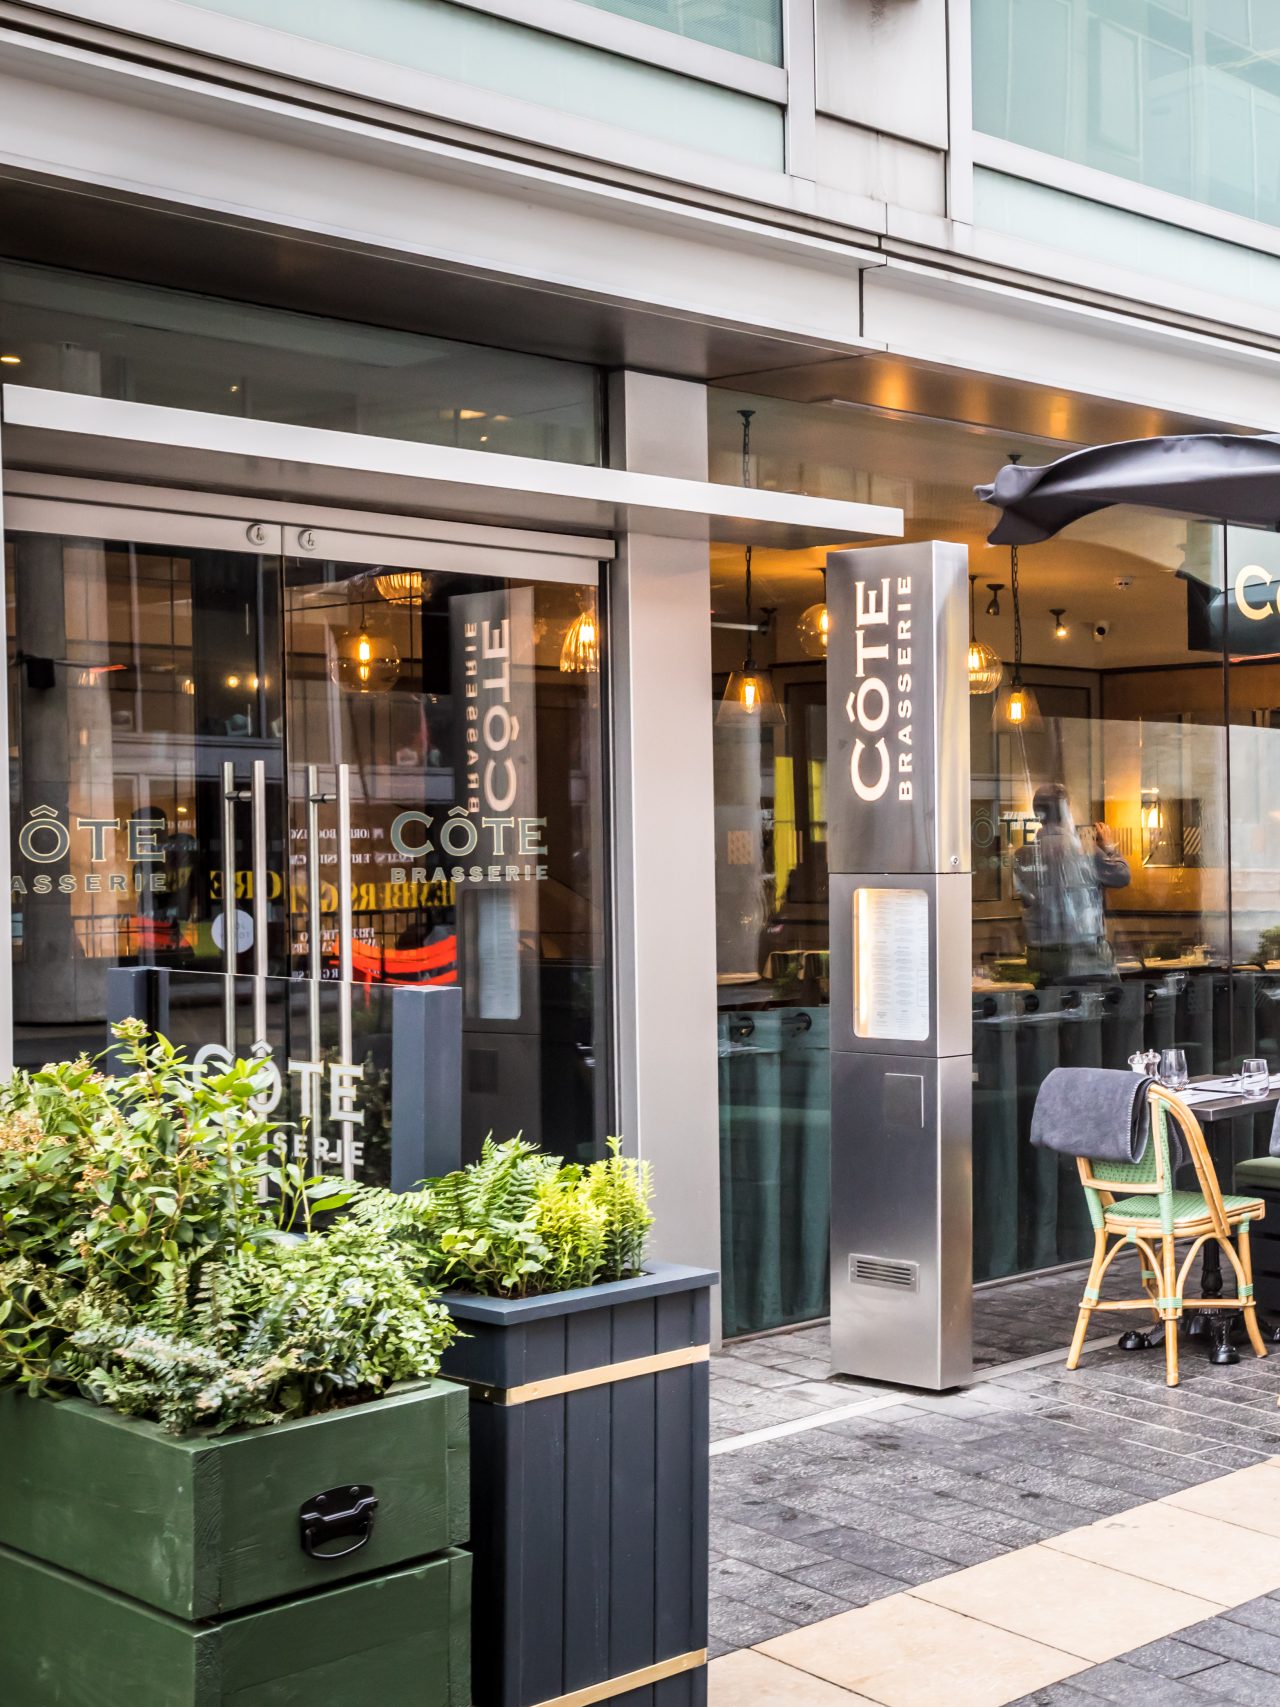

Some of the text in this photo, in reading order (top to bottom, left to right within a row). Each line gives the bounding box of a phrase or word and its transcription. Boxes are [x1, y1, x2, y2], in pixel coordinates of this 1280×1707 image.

[845, 577, 891, 801] CÔTE
[897, 575, 913, 801] BRASSERIE
[390, 805, 549, 858] CÔTE
[390, 864, 549, 885] BRASSERIE
